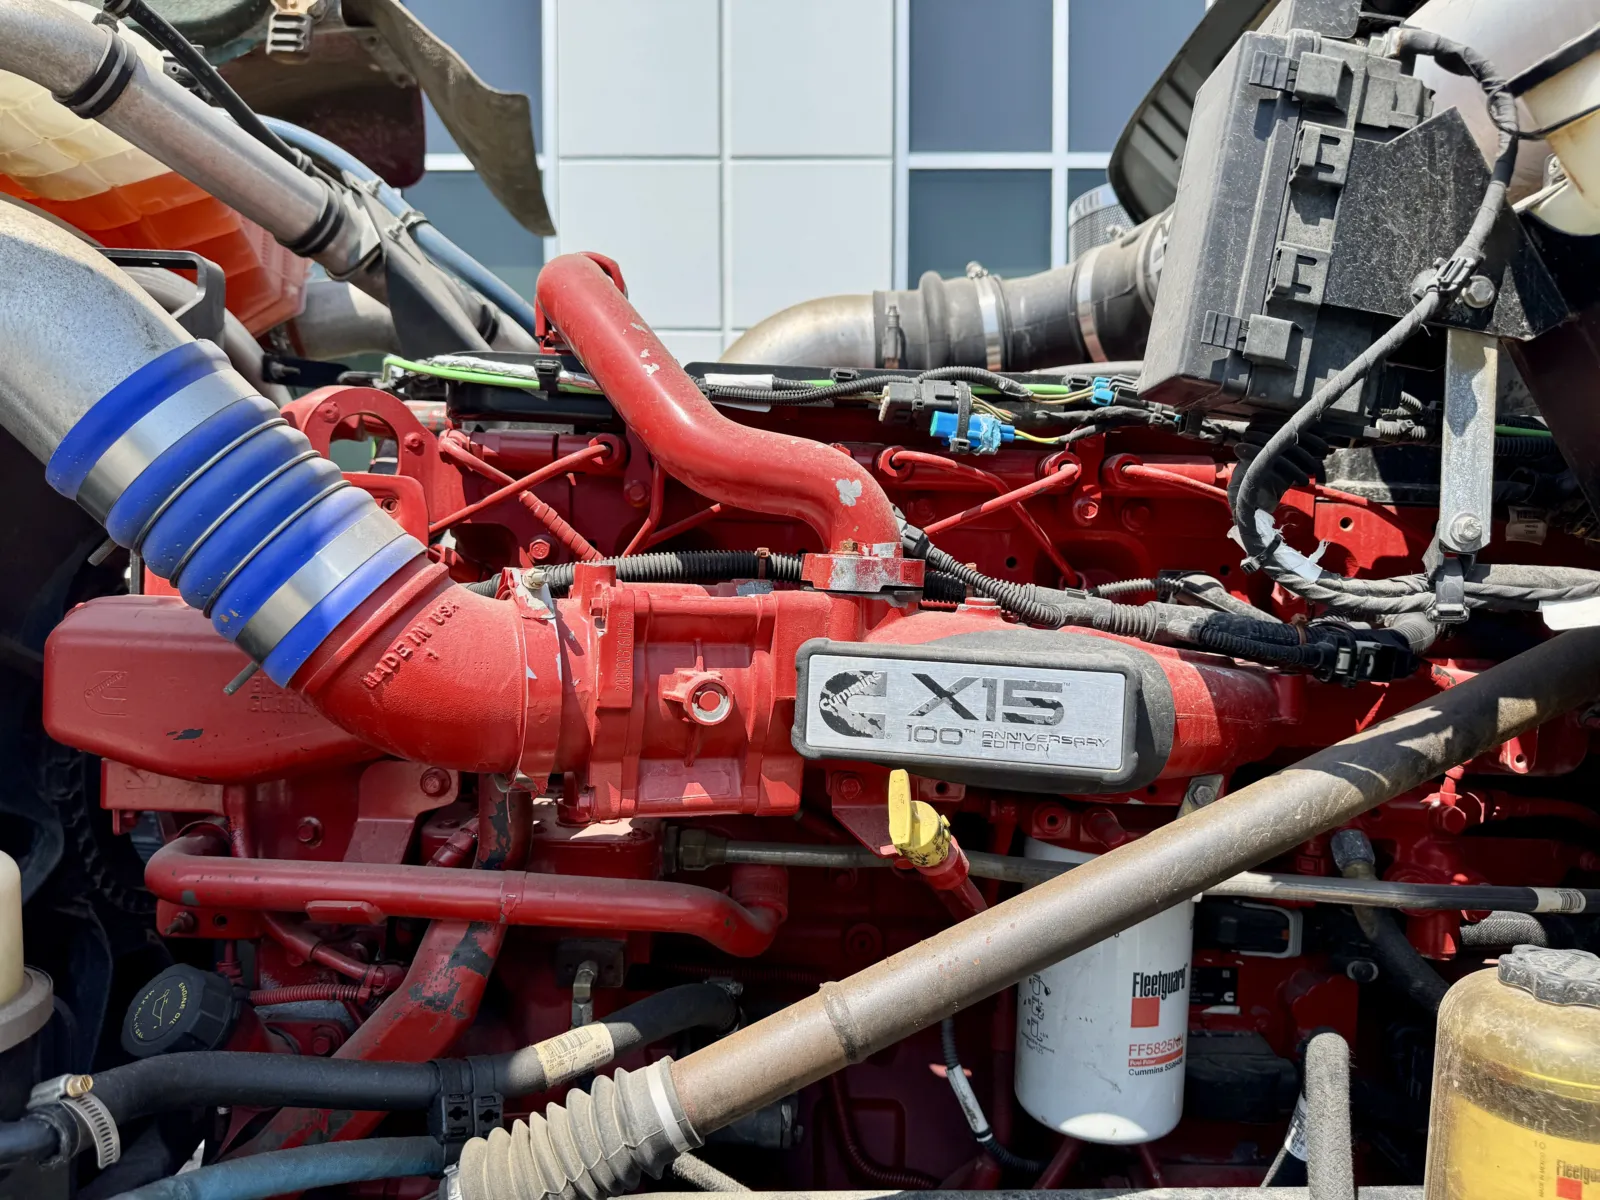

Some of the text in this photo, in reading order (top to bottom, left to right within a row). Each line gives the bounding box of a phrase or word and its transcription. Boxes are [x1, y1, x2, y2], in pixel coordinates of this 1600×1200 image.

[361, 601, 460, 689] MADE IN USA
[820, 670, 882, 711] Cummins
[908, 673, 1065, 726] X15
[982, 730, 1110, 748] ANNIVERSARY
[982, 739, 1049, 752] EDITION
[1132, 967, 1187, 1000] Fleetguard
[169, 982, 188, 1025] ENGINE OIL
[1128, 1065, 1163, 1076] Cummins
[1556, 1159, 1600, 1185] Fleetgu
